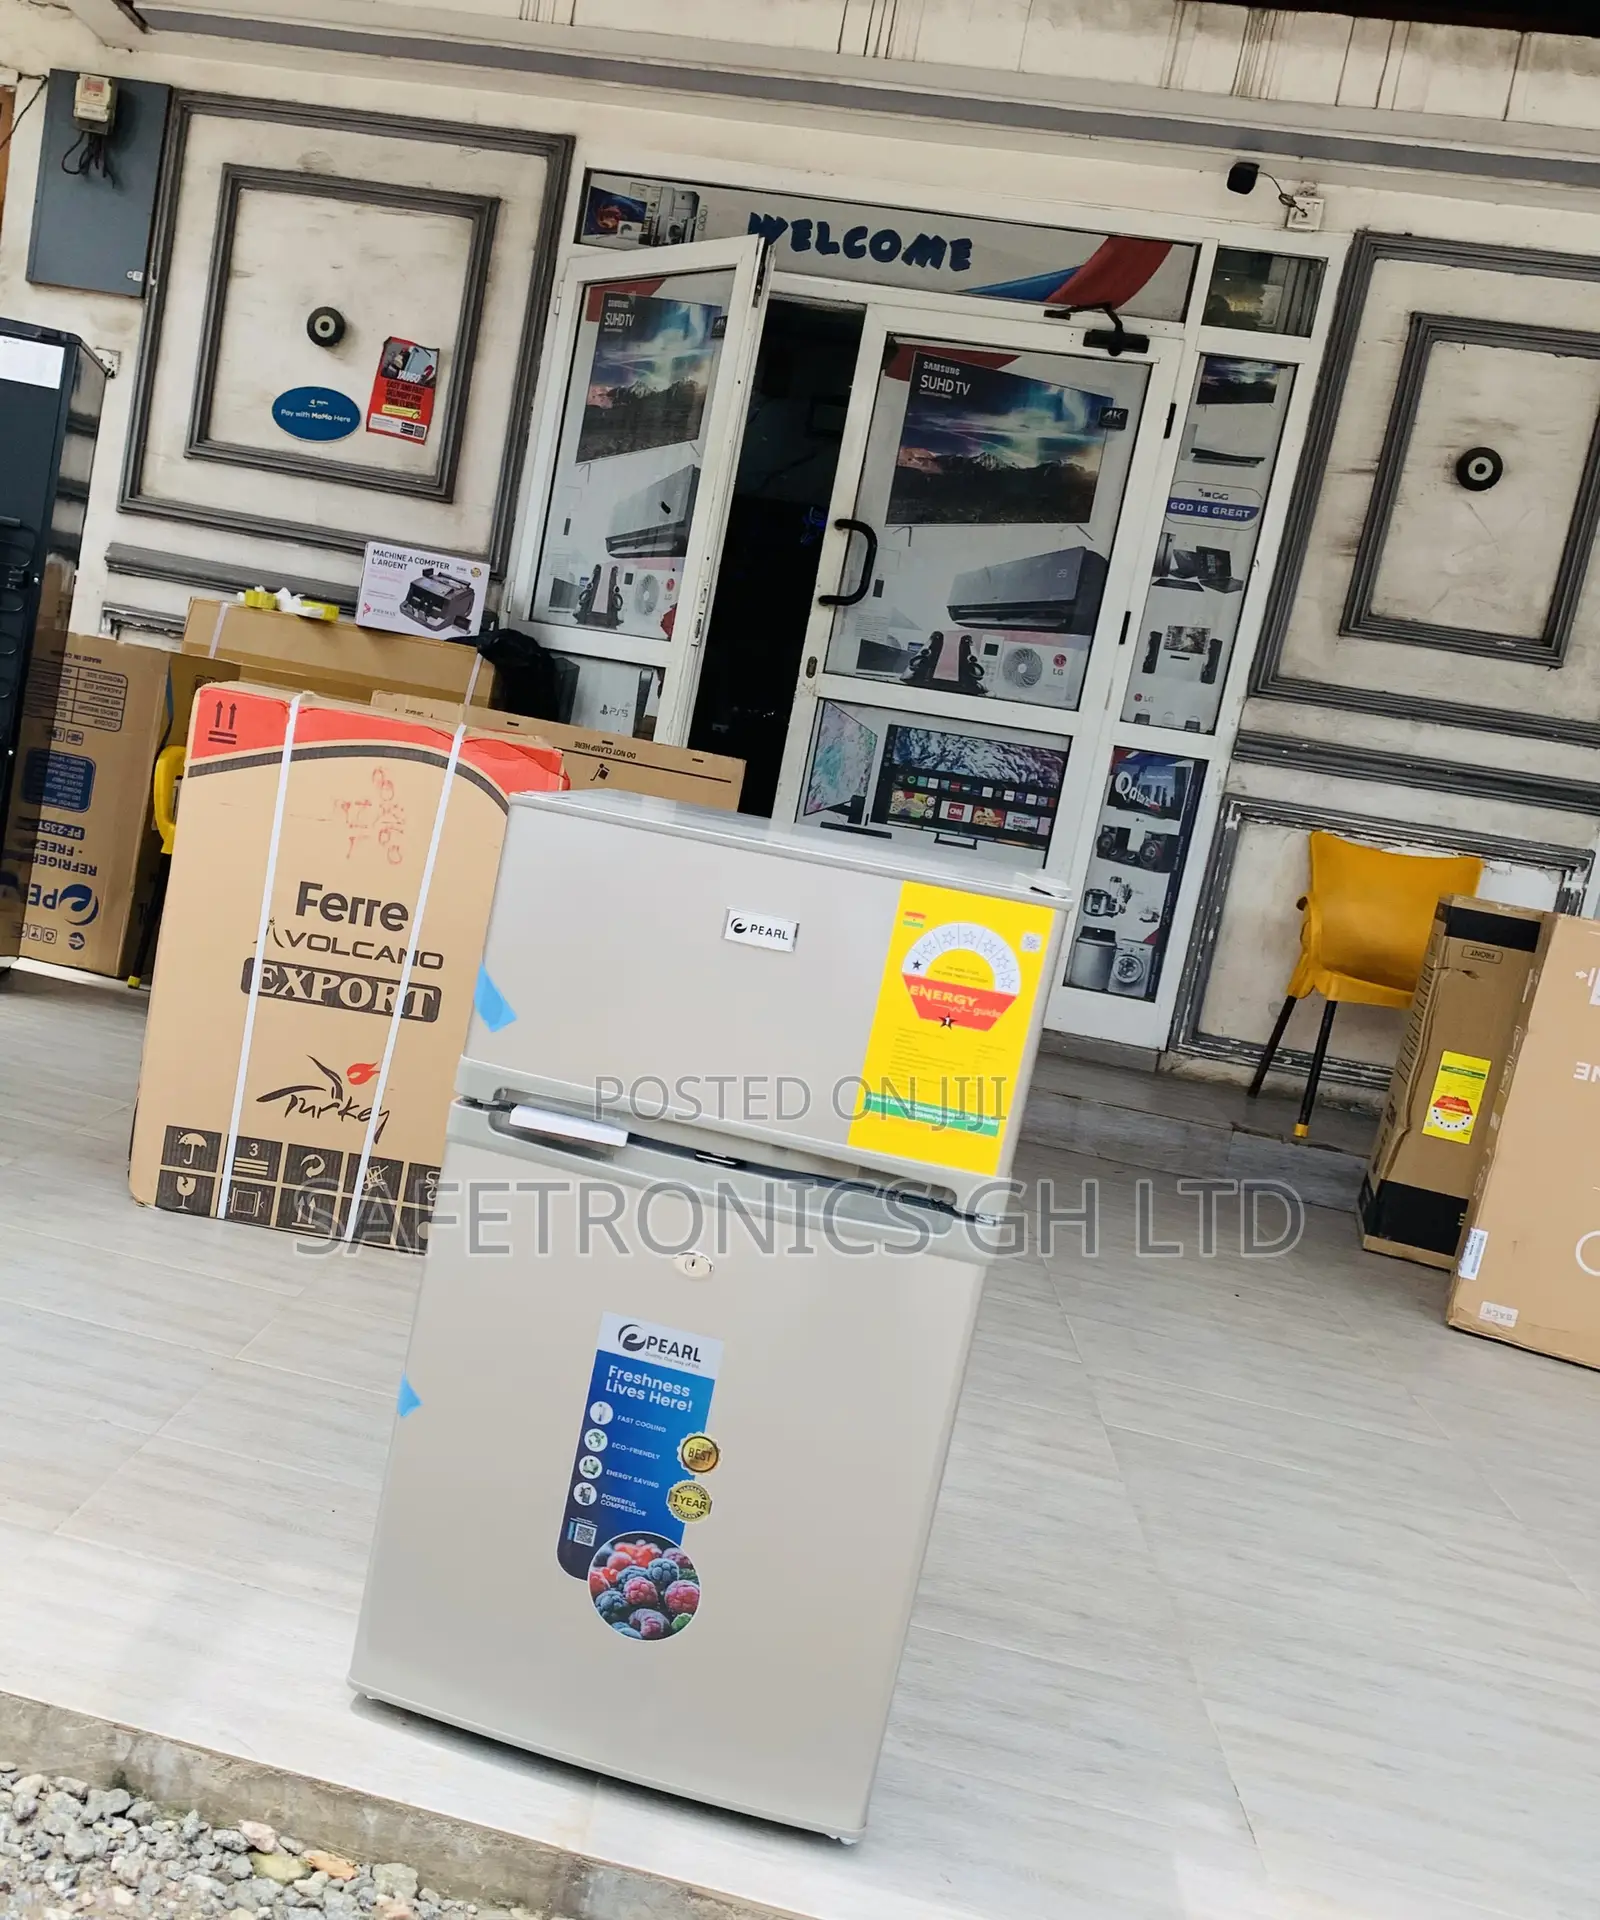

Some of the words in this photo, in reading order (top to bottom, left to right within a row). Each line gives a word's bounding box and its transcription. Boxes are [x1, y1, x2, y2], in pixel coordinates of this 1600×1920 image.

[748, 212, 973, 272] WELCOME
[923, 361, 960, 376] SAMSUNG
[920, 374, 954, 393] SUHD
[955, 381, 971, 396] TV
[281, 408, 295, 418] Pay
[295, 410, 310, 419] with
[311, 412, 333, 421] MoMo
[333, 415, 351, 423] Here
[1171, 502, 1194, 512] GOD
[1197, 504, 1208, 514] IS
[1212, 506, 1250, 518] GREAT
[371, 558, 408, 571] L'ARGENT
[373, 549, 408, 561] MACHINE
[408, 555, 414, 563] A
[414, 557, 450, 570] COMPTER
[1052, 668, 1064, 676] LG
[608, 707, 629, 718] PS5
[574, 740, 591, 751] HERE
[613, 748, 627, 758] NOT
[627, 751, 637, 760] DO
[295, 881, 409, 932] Ferre
[750, 924, 789, 941] PEARL
[284, 929, 444, 970] VOLCANO
[1470, 949, 1496, 961] FRONT
[257, 963, 435, 1018] EXPORT
[973, 1006, 1003, 1020] guide
[249, 1143, 259, 1157] 3
[1485, 1307, 1513, 1321] BACK
[646, 1335, 702, 1363] PEARL
[608, 1365, 691, 1397] Freshness
[605, 1379, 646, 1401] Lives
[648, 1390, 693, 1413] Here!
[617, 1415, 635, 1425] FAST
[634, 1418, 667, 1433] COOLING
[611, 1441, 661, 1461] ECO-FRIENDLY
[687, 1447, 713, 1462] BEST
[606, 1468, 632, 1481] ENERGY
[633, 1475, 660, 1489] SAVING
[600, 1499, 647, 1517] COMPRESSOR
[601, 1493, 637, 1508] POWERFUL
